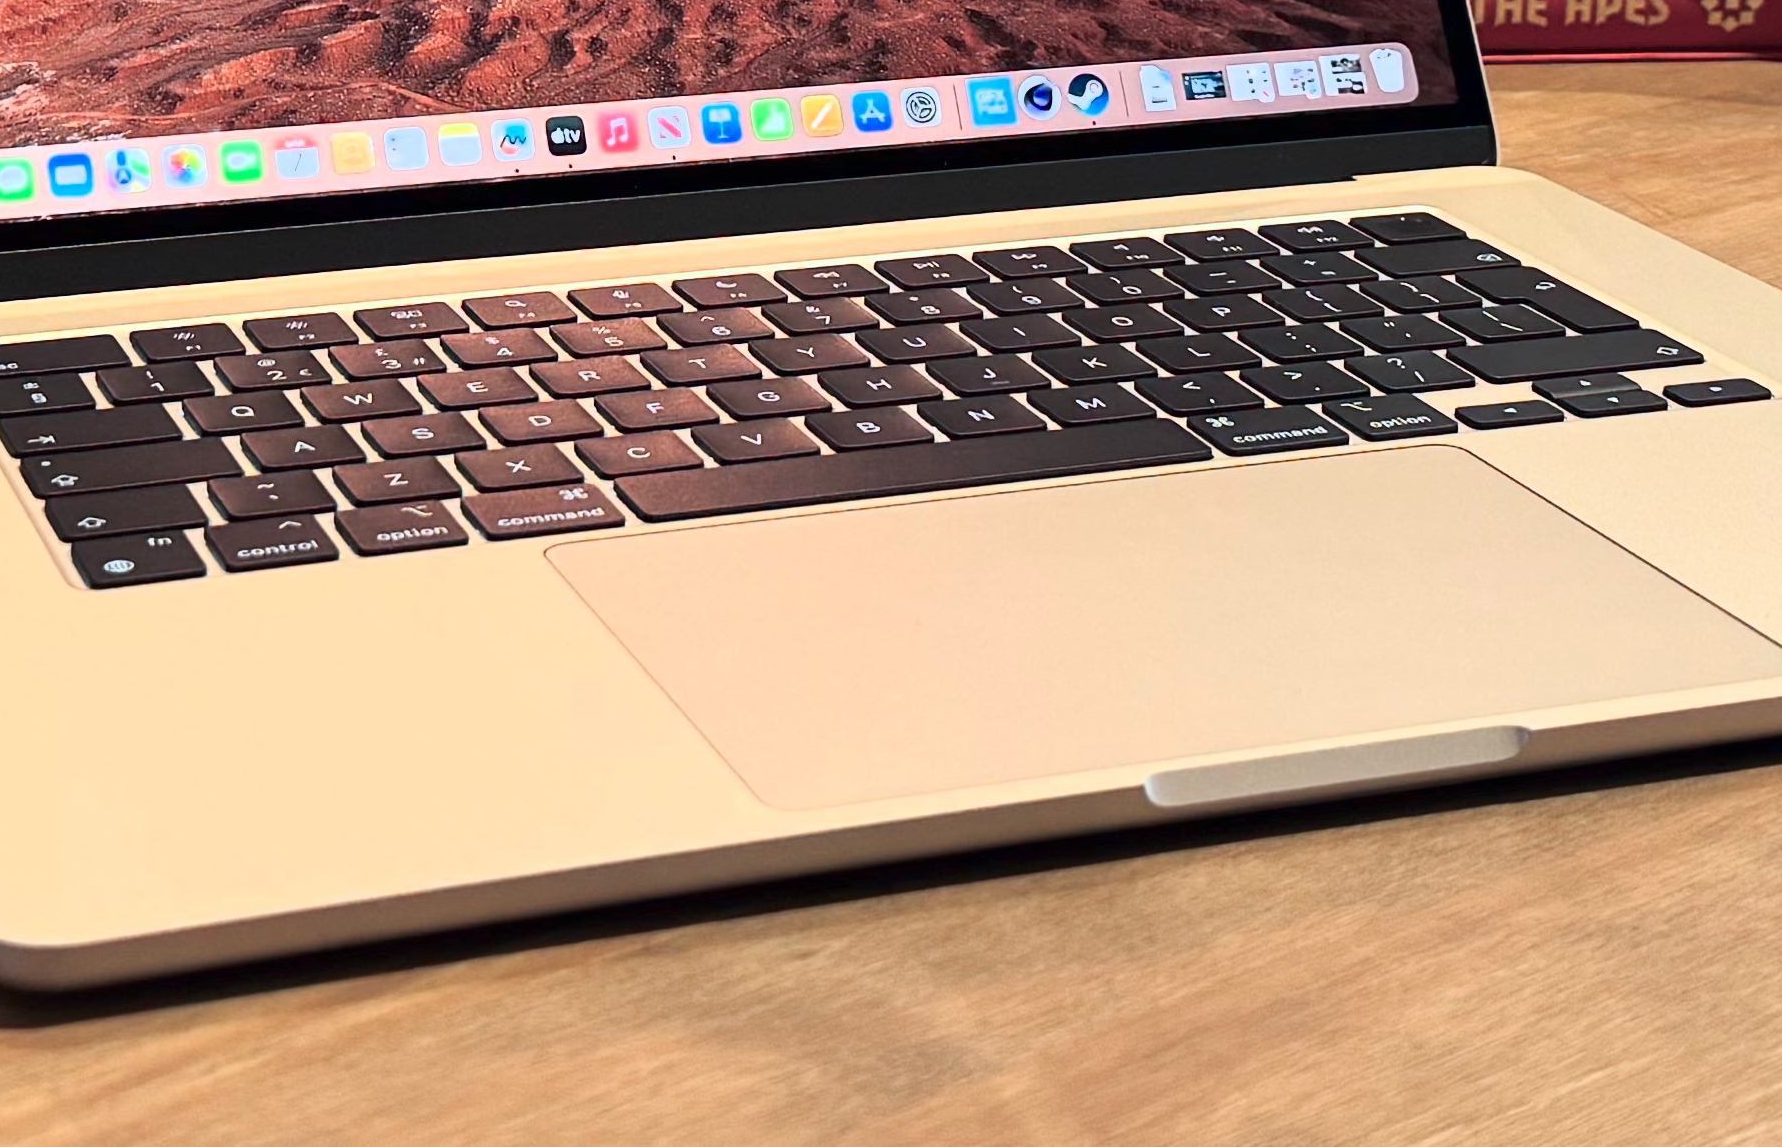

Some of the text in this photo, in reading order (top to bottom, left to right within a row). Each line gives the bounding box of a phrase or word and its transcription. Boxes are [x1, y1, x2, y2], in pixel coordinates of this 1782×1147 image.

[1021, 295, 1042, 305] 9
[921, 305, 940, 315] 8
[1212, 306, 1231, 317] P
[815, 315, 832, 325] 7
[1111, 316, 1133, 327] O
[712, 327, 731, 336] 6
[604, 336, 624, 347] 5
[902, 337, 927, 348] U
[497, 347, 513, 358] 4
[796, 347, 815, 358] Y
[1187, 347, 1211, 357] L
[381, 359, 402, 369] 3
[688, 358, 707, 369] T
[1082, 357, 1107, 368] K
[267, 370, 287, 381] 2
[578, 370, 601, 381] R
[983, 368, 997, 379] J
[151, 382, 164, 392] 1
[467, 381, 488, 393] E
[866, 378, 892, 391] H
[343, 392, 373, 405] W
[757, 391, 780, 402] G
[646, 402, 665, 414] F
[1075, 397, 1106, 410] M
[231, 406, 255, 417] Q
[968, 409, 995, 422] N
[528, 415, 552, 427] D
[1369, 413, 1432, 430] option
[856, 421, 881, 433] B
[412, 428, 434, 440] S
[741, 433, 762, 445] V
[1233, 425, 1328, 444] command
[294, 440, 316, 453] A
[627, 447, 651, 459] C
[505, 460, 532, 473] X
[383, 472, 409, 486] Z
[497, 506, 606, 527] command
[377, 525, 448, 542] option
[147, 536, 172, 546] fn
[237, 539, 319, 558] control
